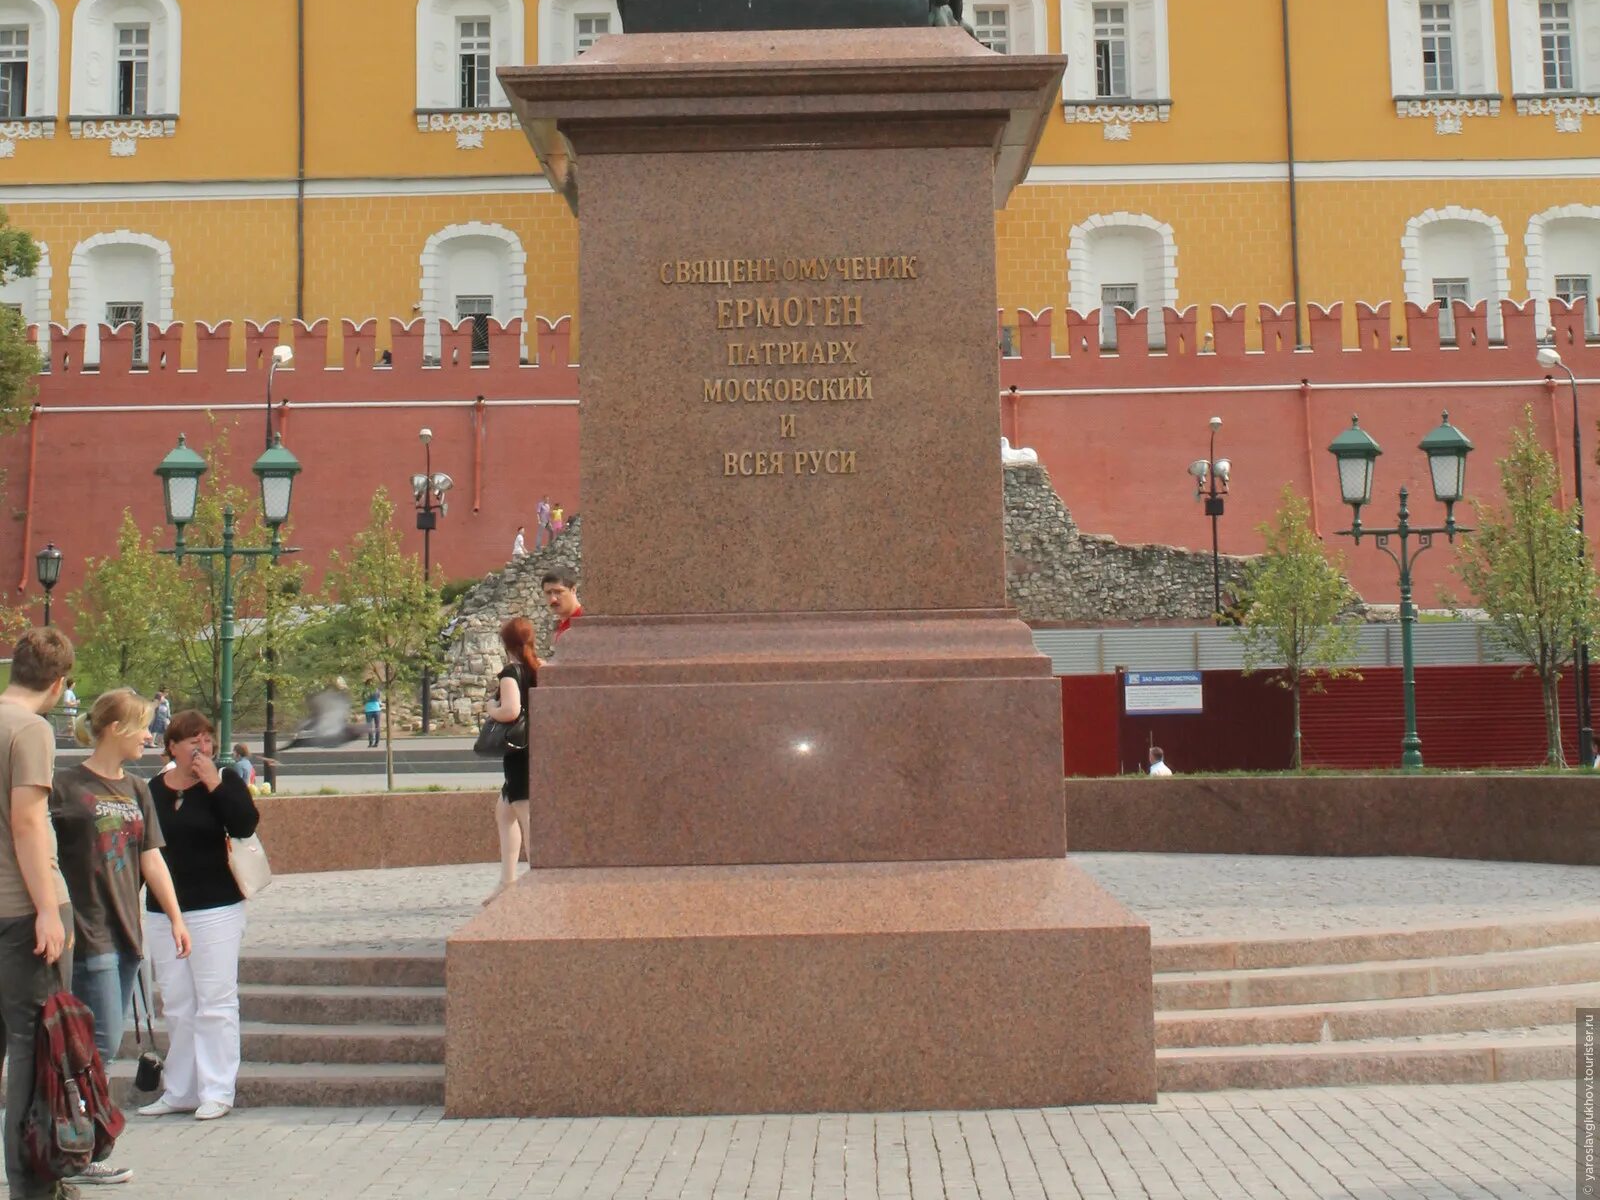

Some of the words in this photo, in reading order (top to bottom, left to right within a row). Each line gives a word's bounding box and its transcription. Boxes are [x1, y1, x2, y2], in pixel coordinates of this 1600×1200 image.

[660, 256, 918, 288] СВЯЩЕННОМУЧЕНИК
[717, 295, 864, 329] ЕРМОГЕН
[727, 341, 857, 366] ПАТРИАРХ
[703, 371, 873, 403] МОСКОВСКИЙ
[779, 414, 797, 438] И
[723, 451, 784, 476] ВСЕЯ
[794, 450, 857, 475] РУСИ
